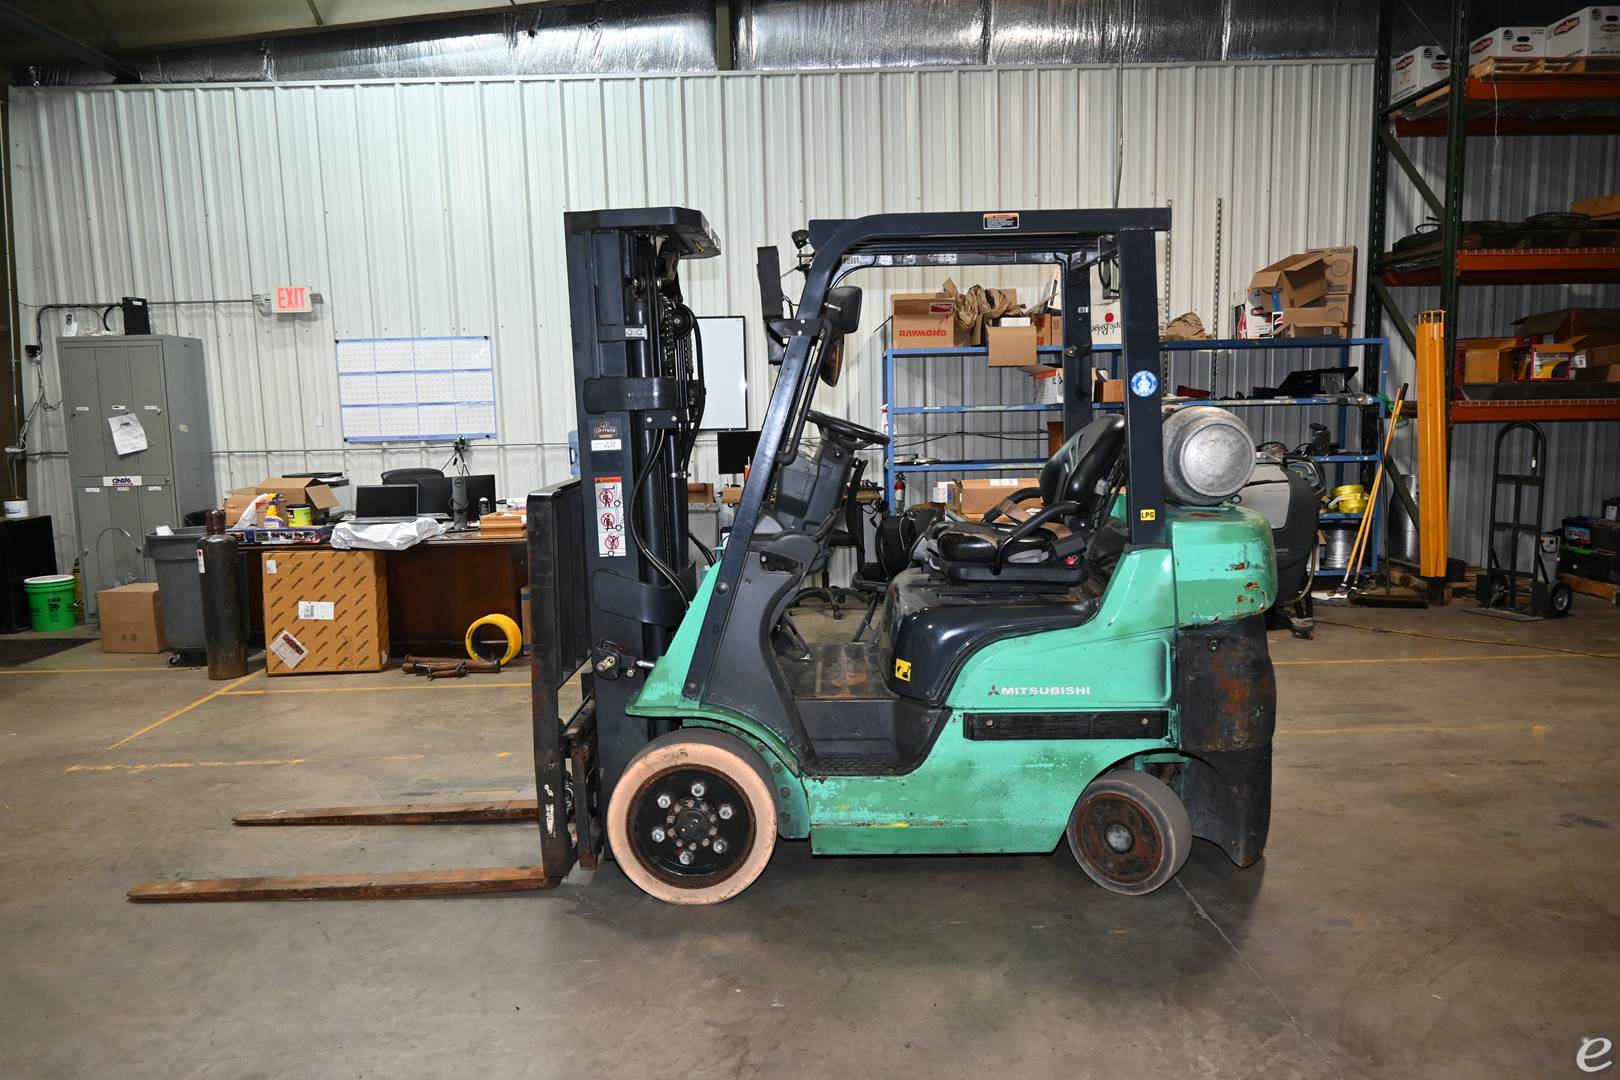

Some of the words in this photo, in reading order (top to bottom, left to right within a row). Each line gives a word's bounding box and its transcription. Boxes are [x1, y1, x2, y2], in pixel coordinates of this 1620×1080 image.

[277, 287, 305, 309] EXIT
[899, 329, 948, 337] RAYMOND
[1141, 511, 1155, 519] LPG
[1001, 686, 1091, 696] MITSUBISHI
